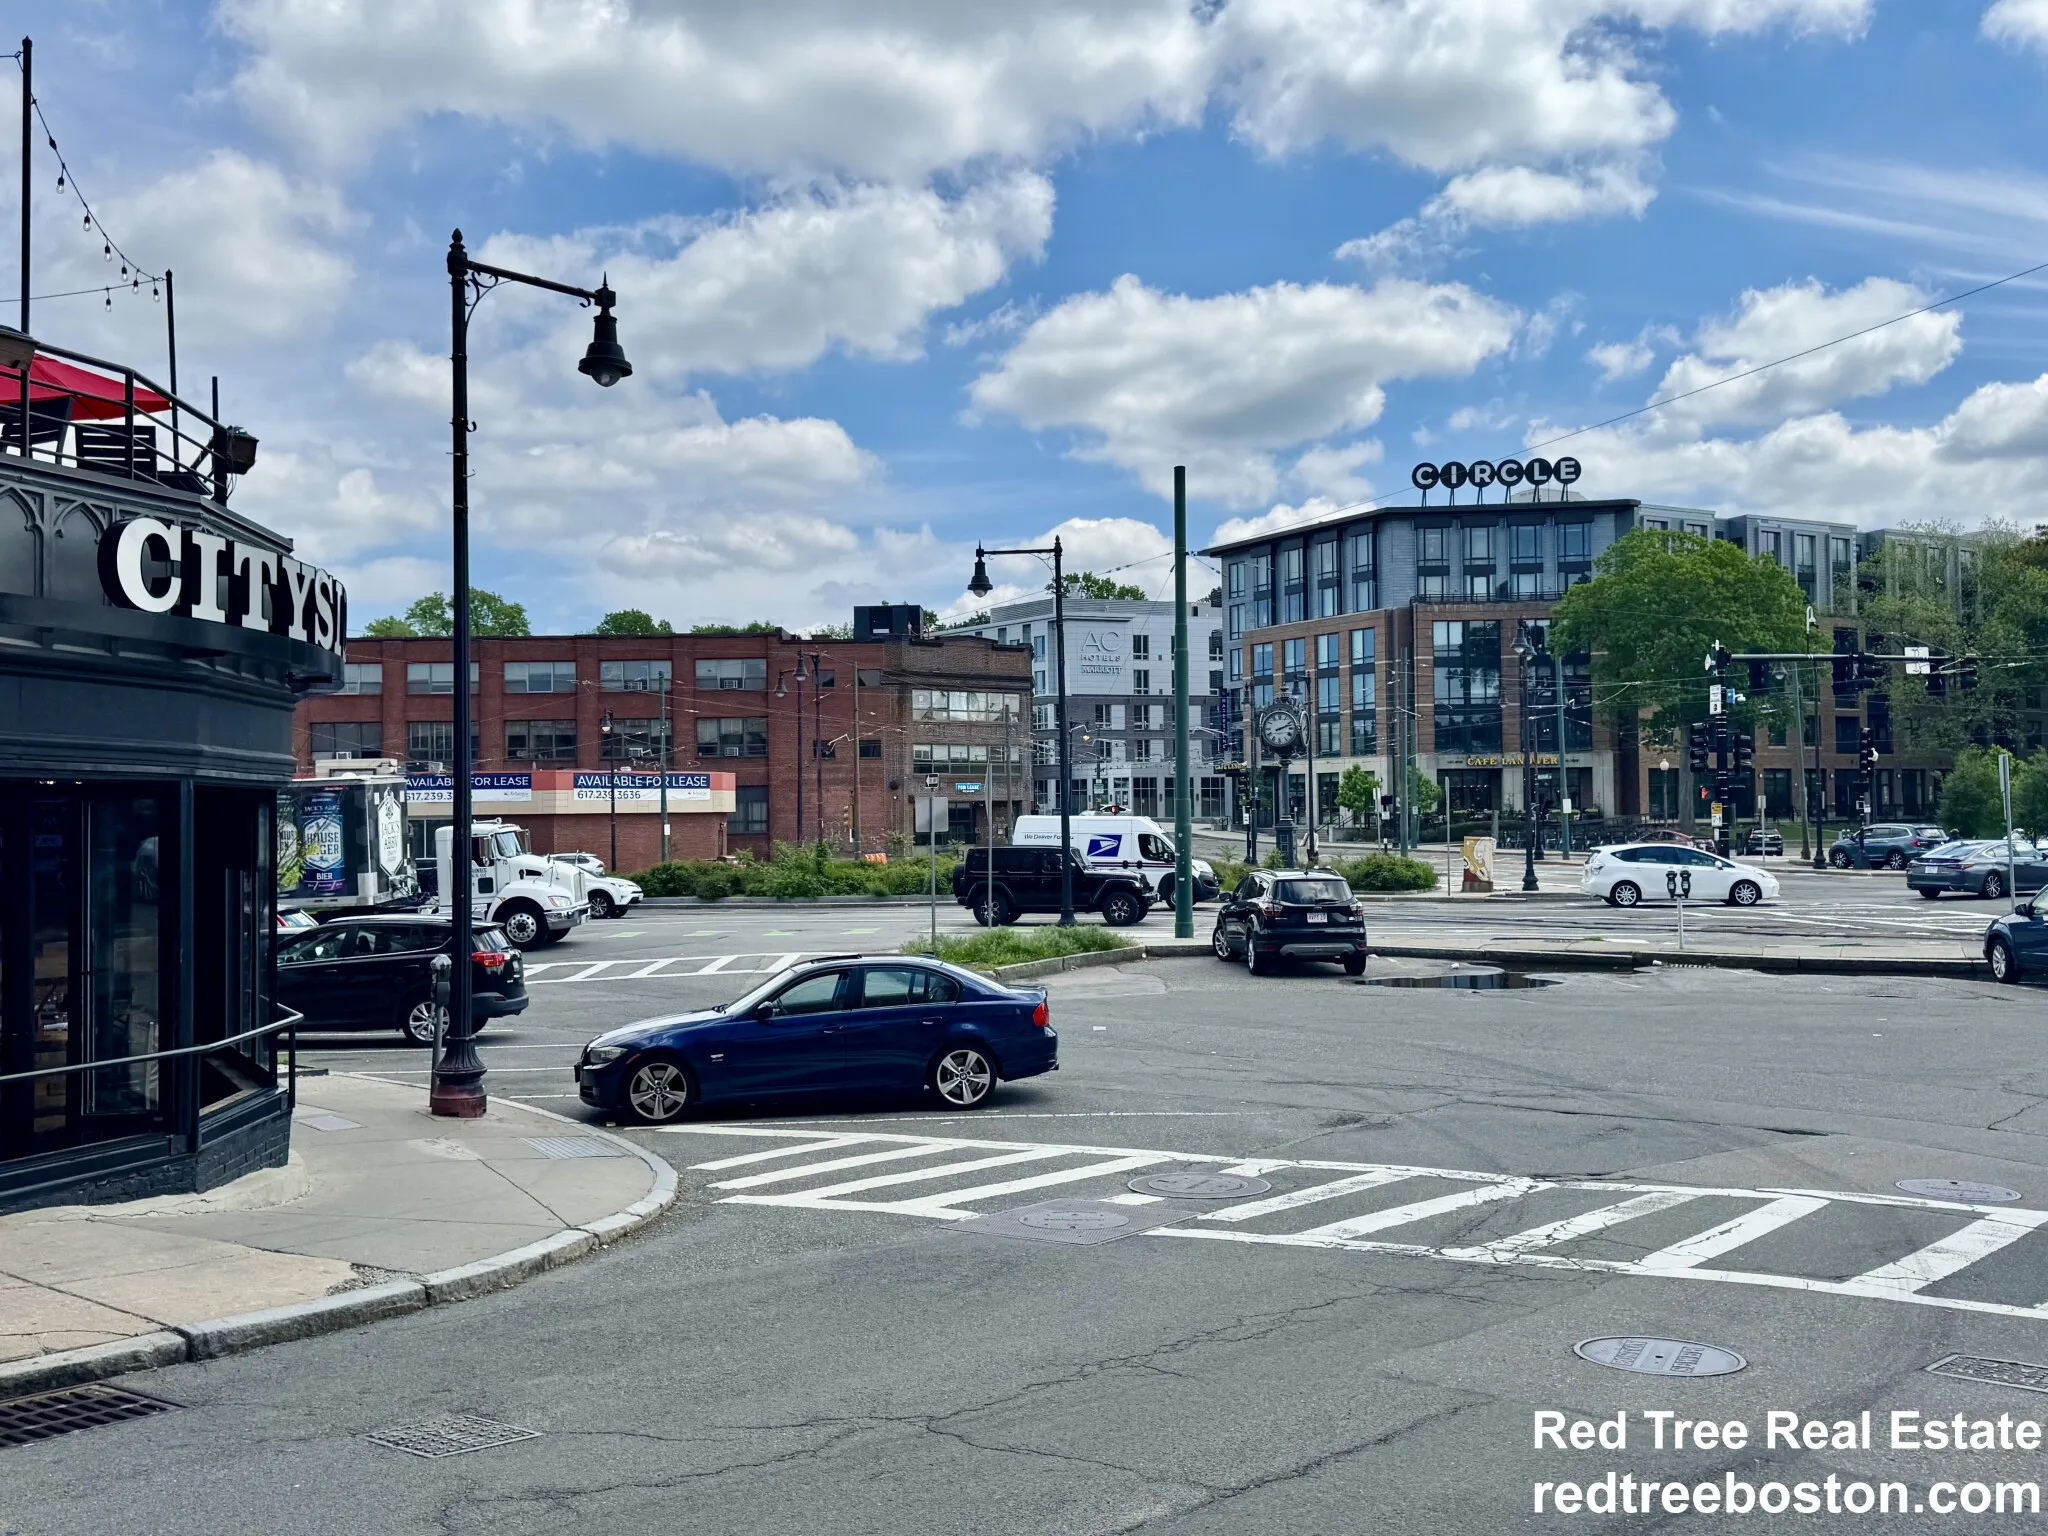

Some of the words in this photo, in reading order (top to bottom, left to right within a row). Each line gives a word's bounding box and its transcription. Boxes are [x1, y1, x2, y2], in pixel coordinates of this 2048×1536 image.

[1415, 460, 1576, 485] CIRCLE
[116, 517, 347, 662] CITYSI
[1081, 631, 1121, 652] AC
[1081, 654, 1121, 662] HOTELS
[1467, 757, 1498, 766] CAFE
[1502, 756, 1558, 766] LANWER
[406, 777, 454, 787] AVAILAB
[494, 776, 529, 786] LEASE
[577, 775, 643, 787] AVAILABLE
[672, 776, 708, 787] LEASE
[405, 791, 454, 801] 617.239.3
[306, 832, 340, 844] HOUSE
[306, 844, 340, 855] GER
[316, 872, 333, 881] BIER
